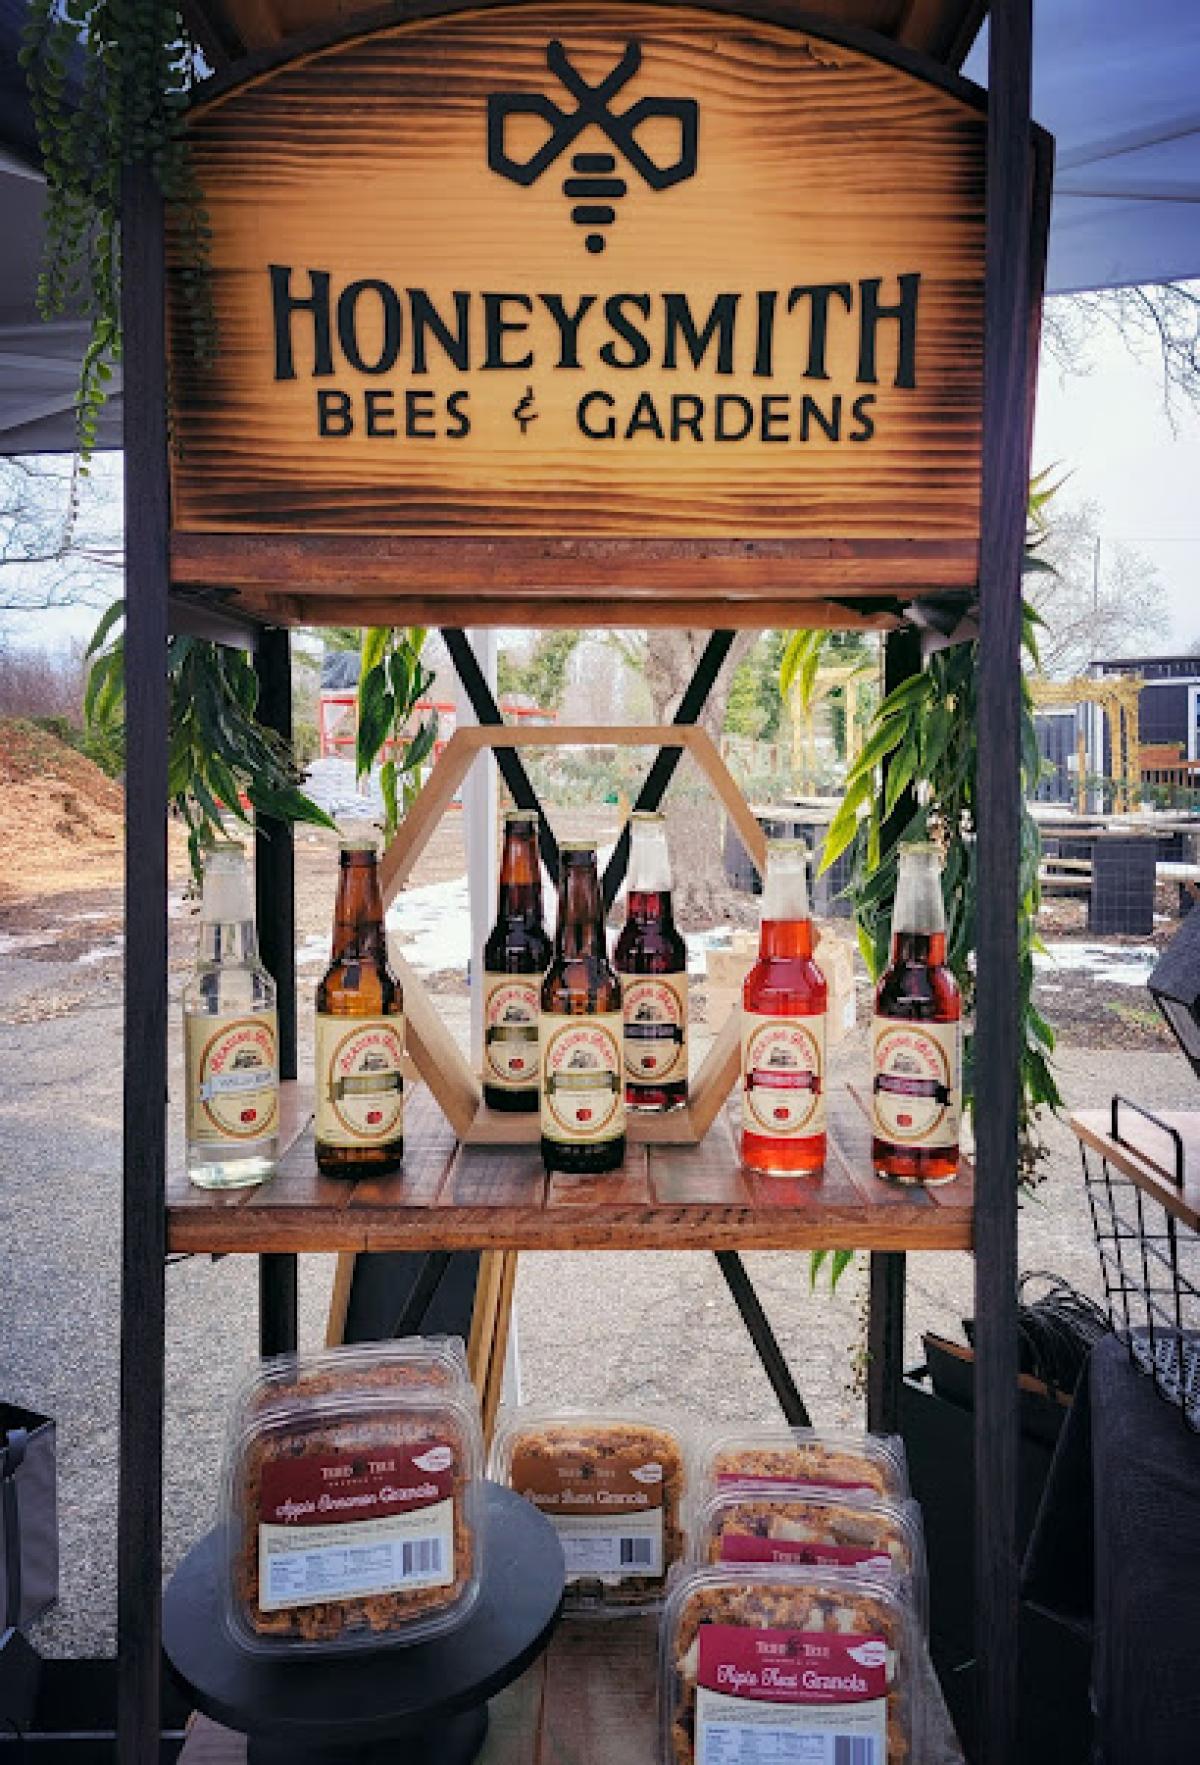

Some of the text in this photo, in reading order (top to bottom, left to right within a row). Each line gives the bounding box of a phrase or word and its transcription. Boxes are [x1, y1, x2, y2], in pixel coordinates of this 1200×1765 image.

[268, 264, 922, 389] HONEYSMITH
[316, 385, 877, 442] BEES & GARDENS
[379, 1482, 439, 1502] Granola
[803, 1671, 868, 1693] Granola
